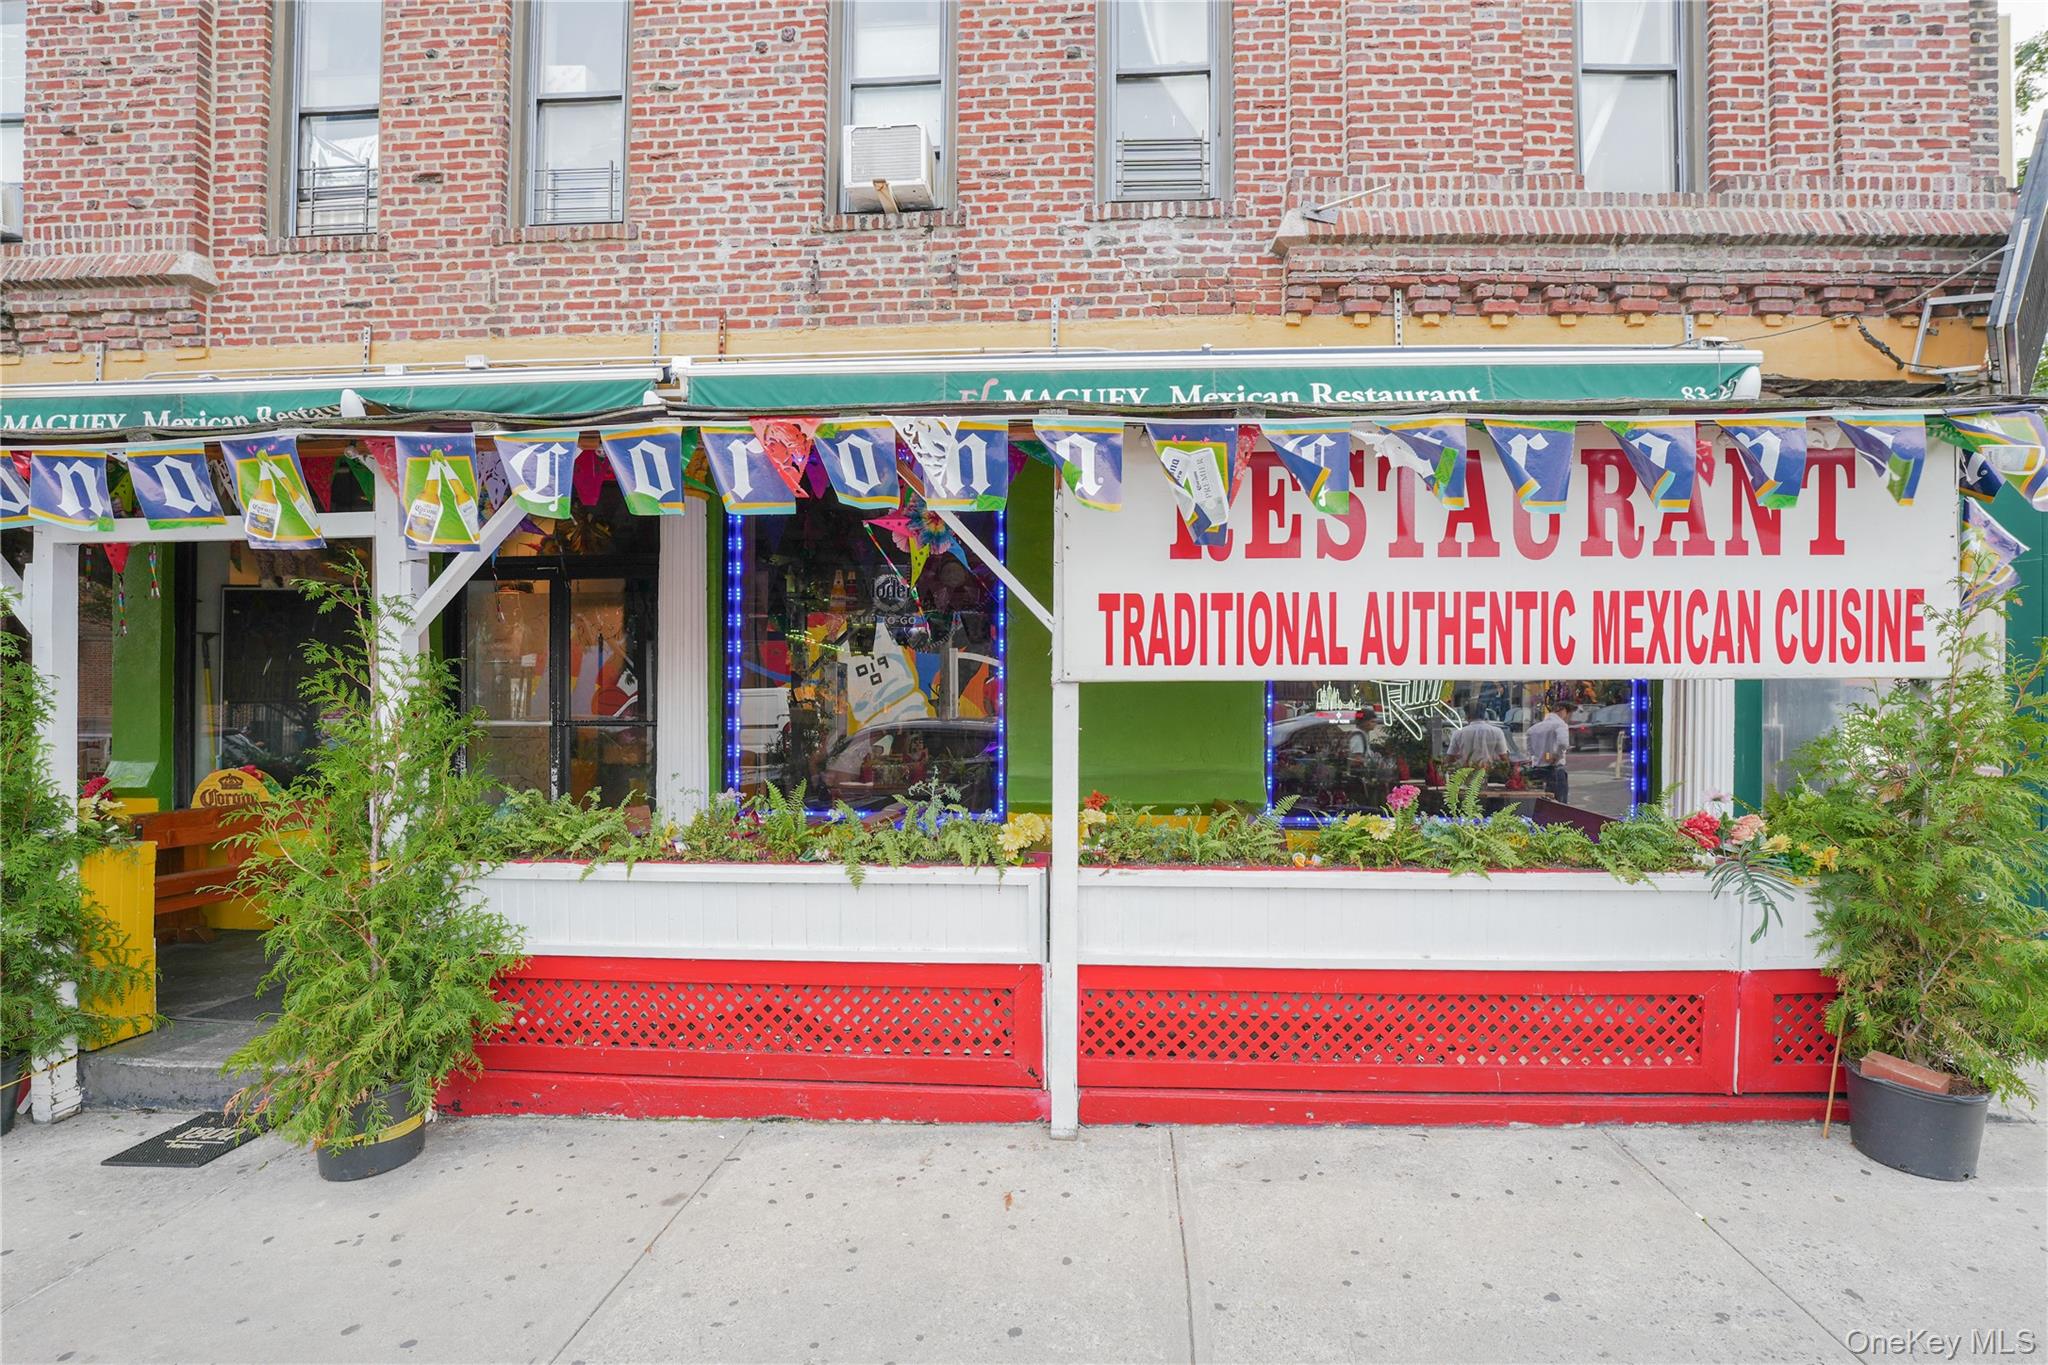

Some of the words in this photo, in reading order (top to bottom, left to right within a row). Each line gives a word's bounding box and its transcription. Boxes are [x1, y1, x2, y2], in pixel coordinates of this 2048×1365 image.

[1169, 384, 1299, 404] Mexican
[1309, 382, 1480, 403] Restaurant
[143, 409, 249, 427] Mexican
[1098, 591, 1348, 667] TRADITIONAL
[1360, 590, 1575, 666] AUTHENTIC
[1593, 588, 1760, 664] MEXICAN
[1775, 587, 1925, 664] CUISINE
